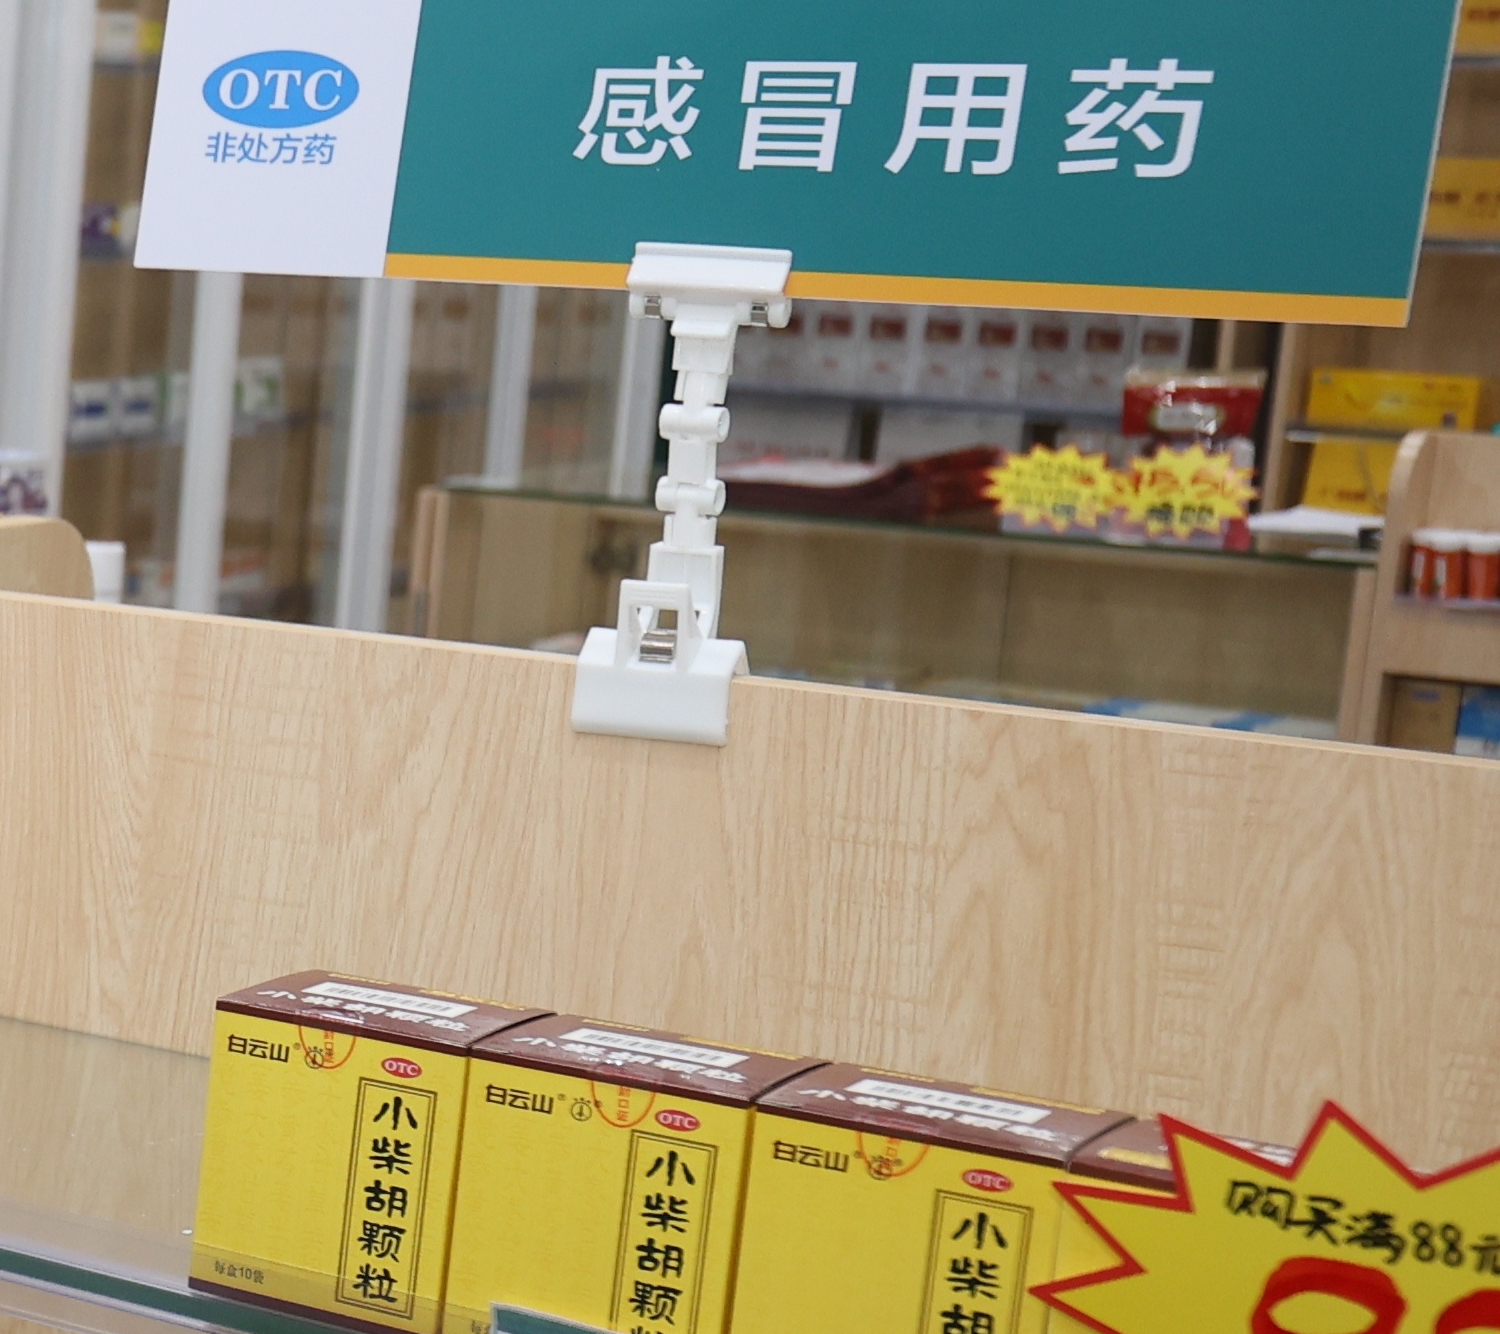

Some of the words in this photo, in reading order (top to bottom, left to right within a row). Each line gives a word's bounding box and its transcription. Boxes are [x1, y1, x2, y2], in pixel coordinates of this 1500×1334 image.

[216, 66, 345, 111] OTC
[572, 55, 1216, 181] 感冒用药
[204, 129, 337, 167] 非处方药
[256, 989, 470, 1032] 小柴胡颗粒
[227, 1033, 291, 1063] 白云山
[511, 1035, 747, 1084] 小柴胡颗粒
[384, 1060, 420, 1077] OTC
[485, 1083, 554, 1115] 白云山
[657, 1111, 696, 1130] OTC
[771, 1139, 849, 1173] 白云山
[966, 1171, 1009, 1191] OTC
[352, 1095, 419, 1304] 小柴胡颗粒
